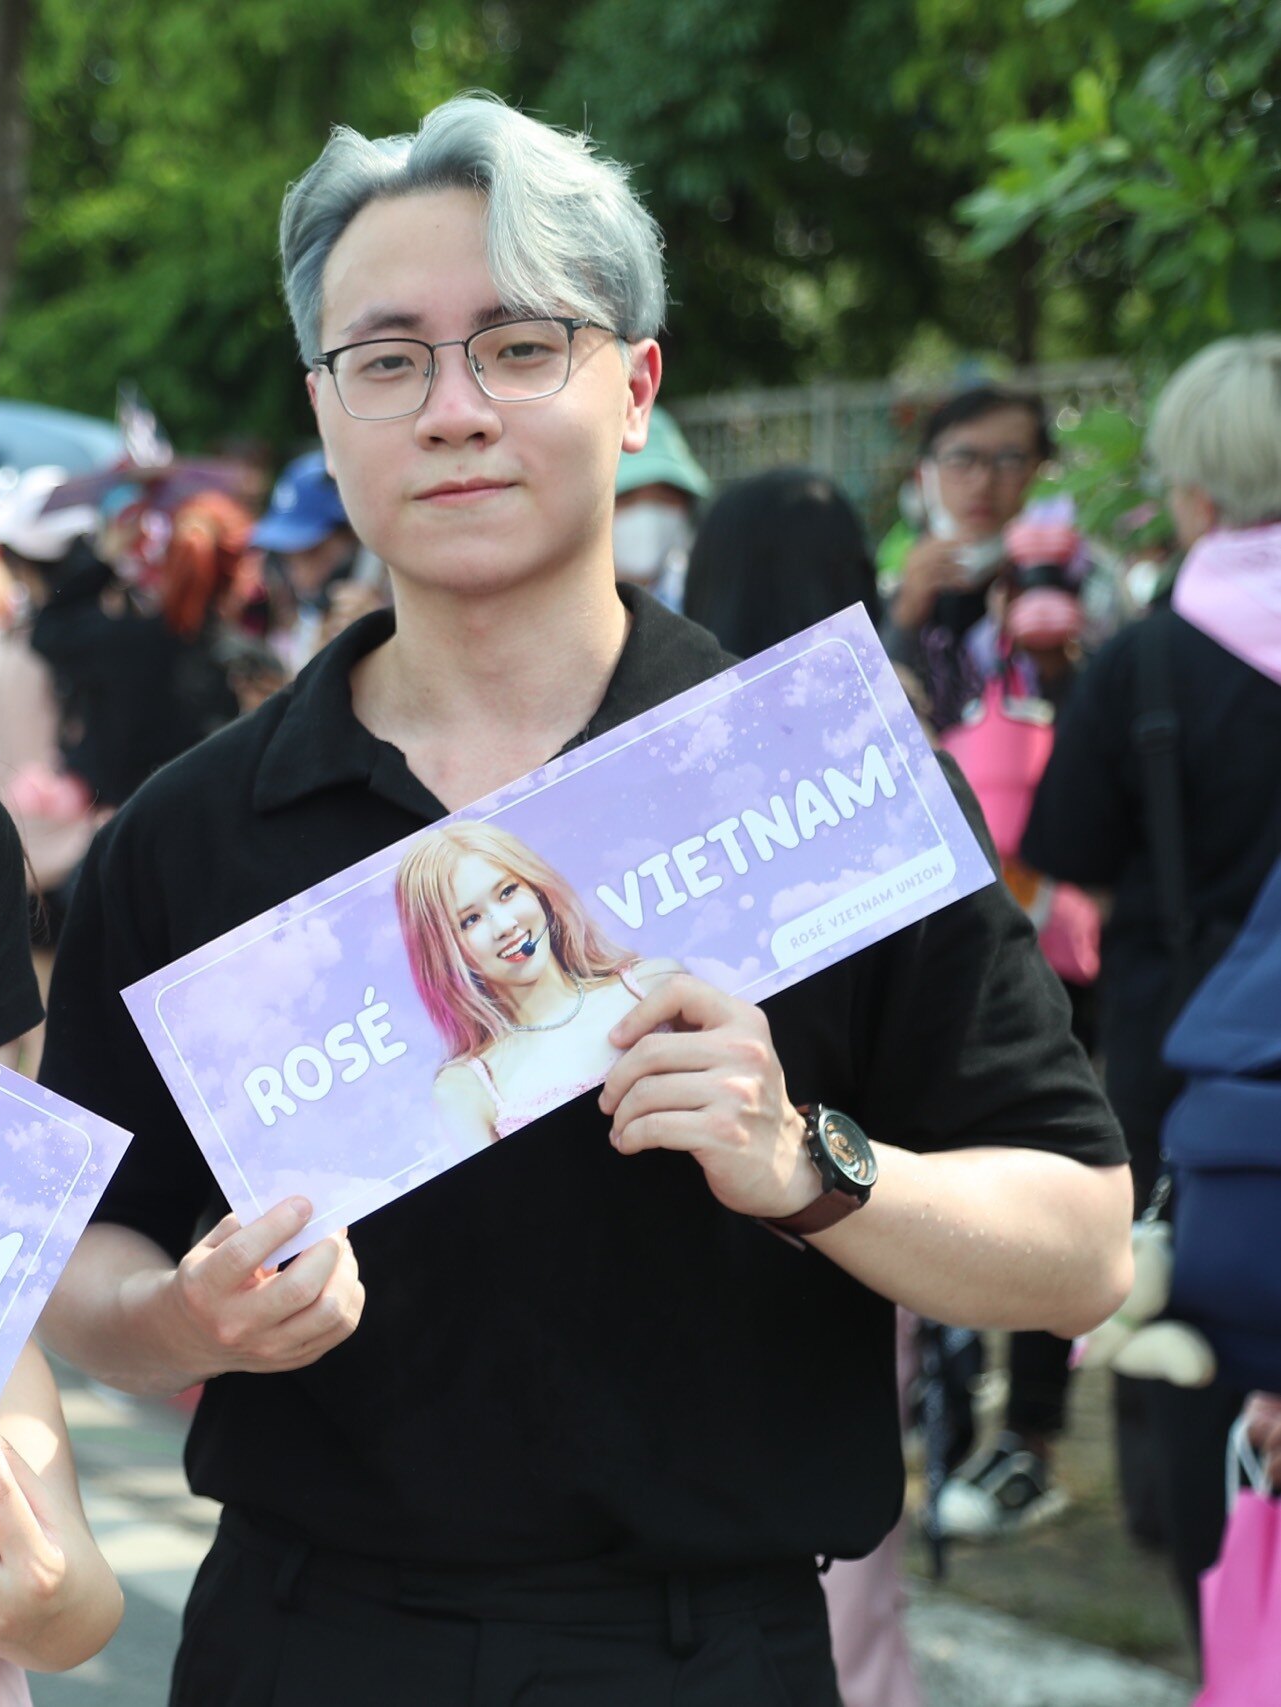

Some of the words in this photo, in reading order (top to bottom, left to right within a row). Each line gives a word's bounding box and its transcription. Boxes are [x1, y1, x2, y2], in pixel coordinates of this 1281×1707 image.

[243, 985, 408, 1127] ROSÉ
[596, 744, 897, 929] VIETNAM
[789, 916, 826, 950] ROSÉ
[827, 887, 894, 928] VIETNAM
[895, 862, 944, 895] UNION
